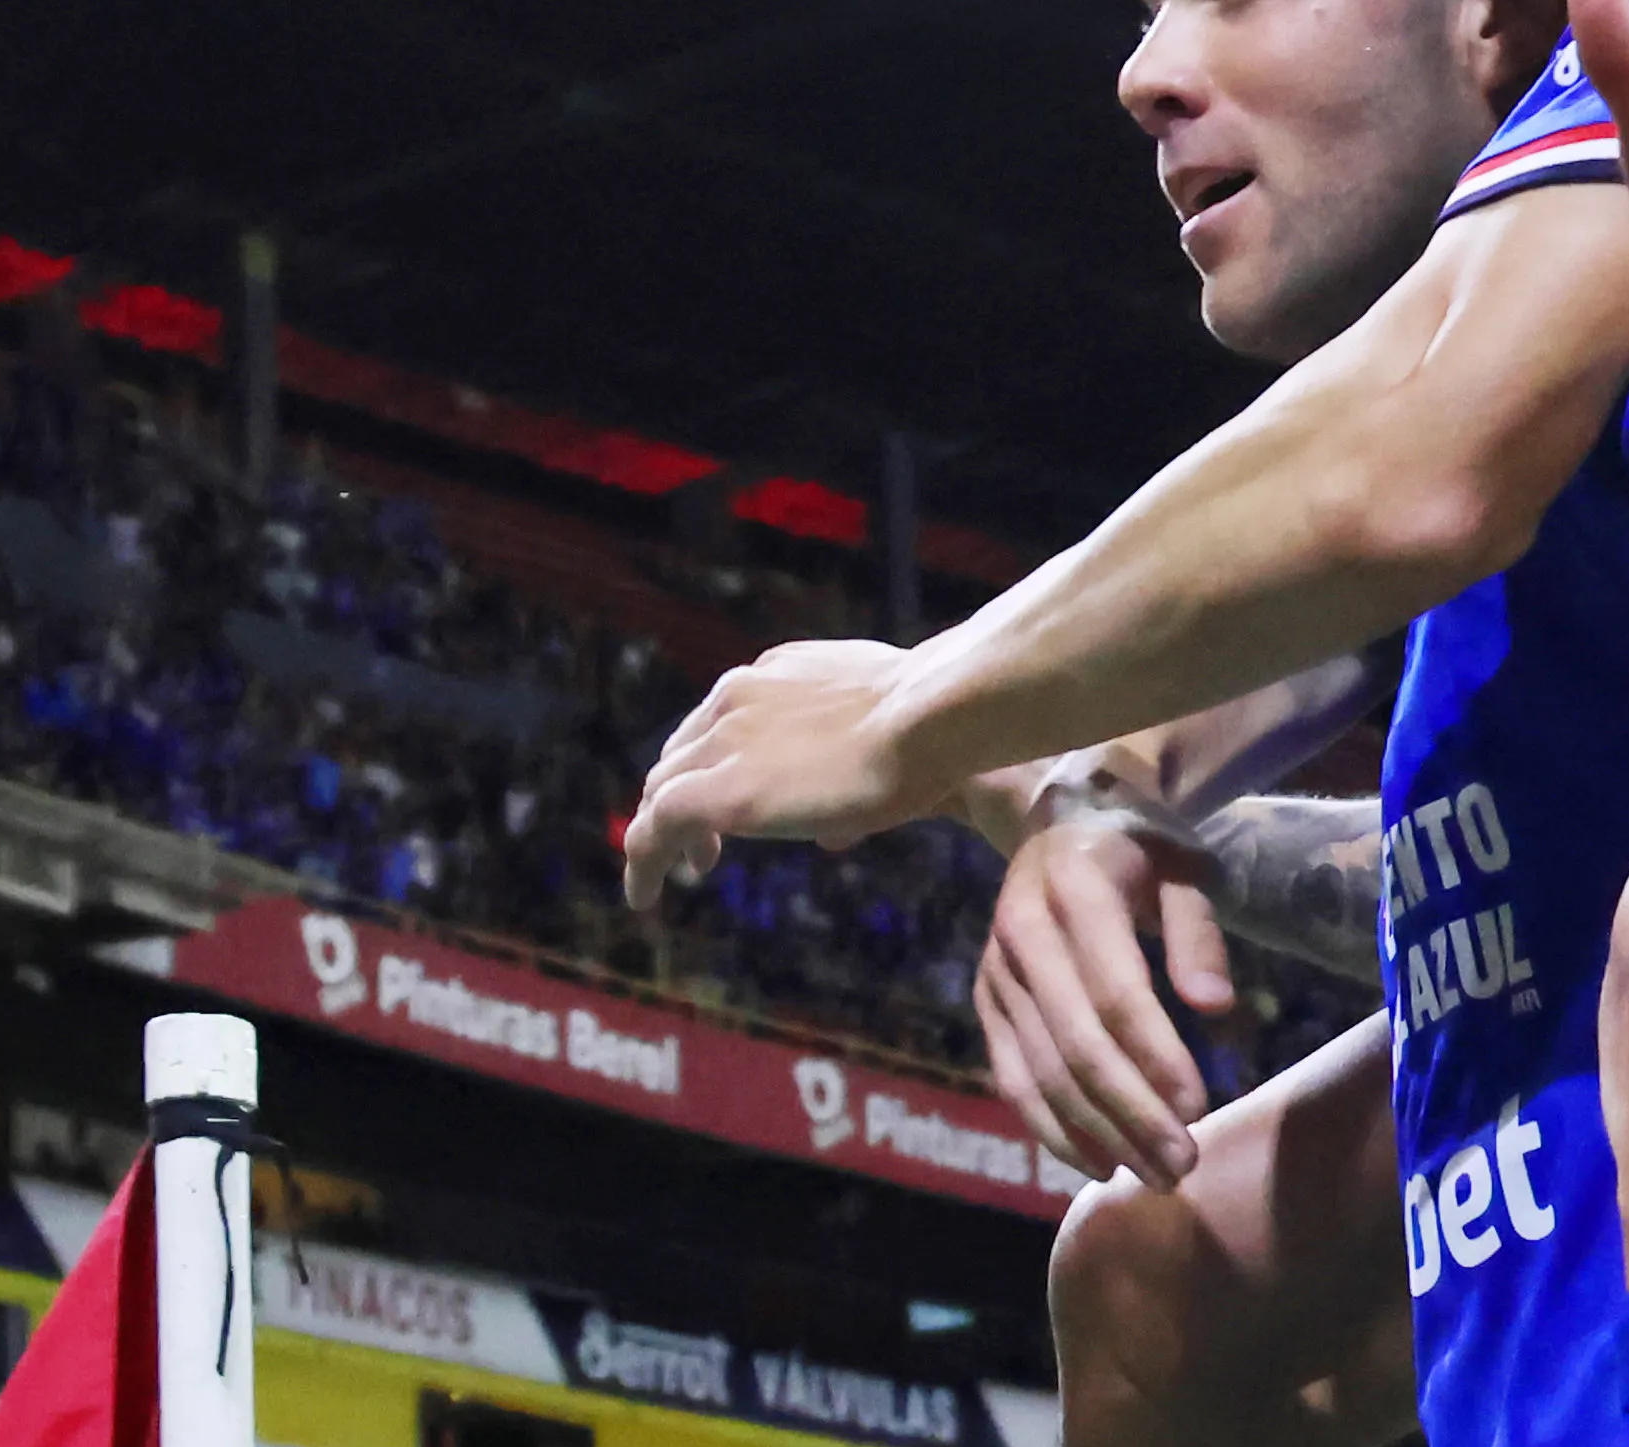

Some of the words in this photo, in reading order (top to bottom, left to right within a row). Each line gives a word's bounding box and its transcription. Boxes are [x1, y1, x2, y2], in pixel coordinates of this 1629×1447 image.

[1382, 782, 1512, 922] ENTO
[377, 955, 559, 1062] Pinturas
[1408, 902, 1538, 1031] AZUL
